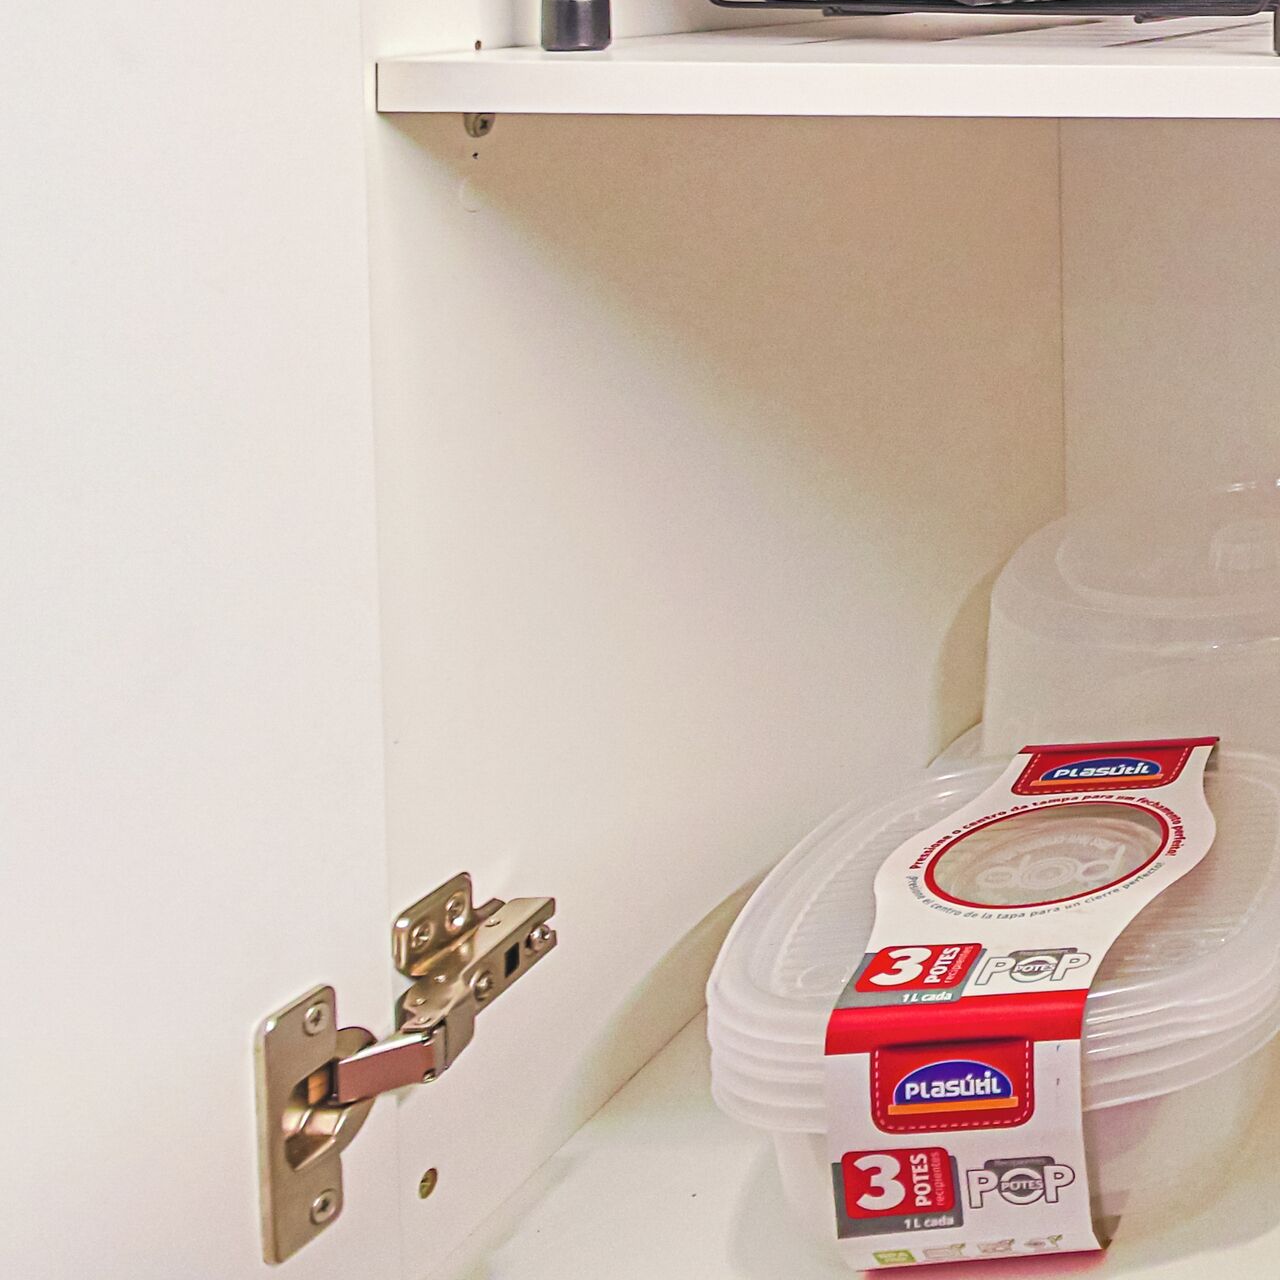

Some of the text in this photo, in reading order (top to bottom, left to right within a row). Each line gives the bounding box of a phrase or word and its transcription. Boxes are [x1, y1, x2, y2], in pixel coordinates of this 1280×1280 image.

[962, 810, 1008, 830] centro
[1032, 795, 1079, 807] tampa
[963, 910, 979, 919] de
[980, 911, 993, 920] la
[996, 912, 1026, 920] tapa
[1029, 906, 1061, 918] para
[868, 946, 932, 987] 3
[923, 947, 962, 985] POTES
[974, 952, 1092, 986] POP
[902, 991, 953, 1003] 1 L cada
[852, 1153, 906, 1211] 3
[910, 1152, 932, 1208] POTES
[965, 1163, 1076, 1209] POP
[1000, 1180, 1043, 1191] POTES
[903, 1214, 954, 1229] 1 L cada
